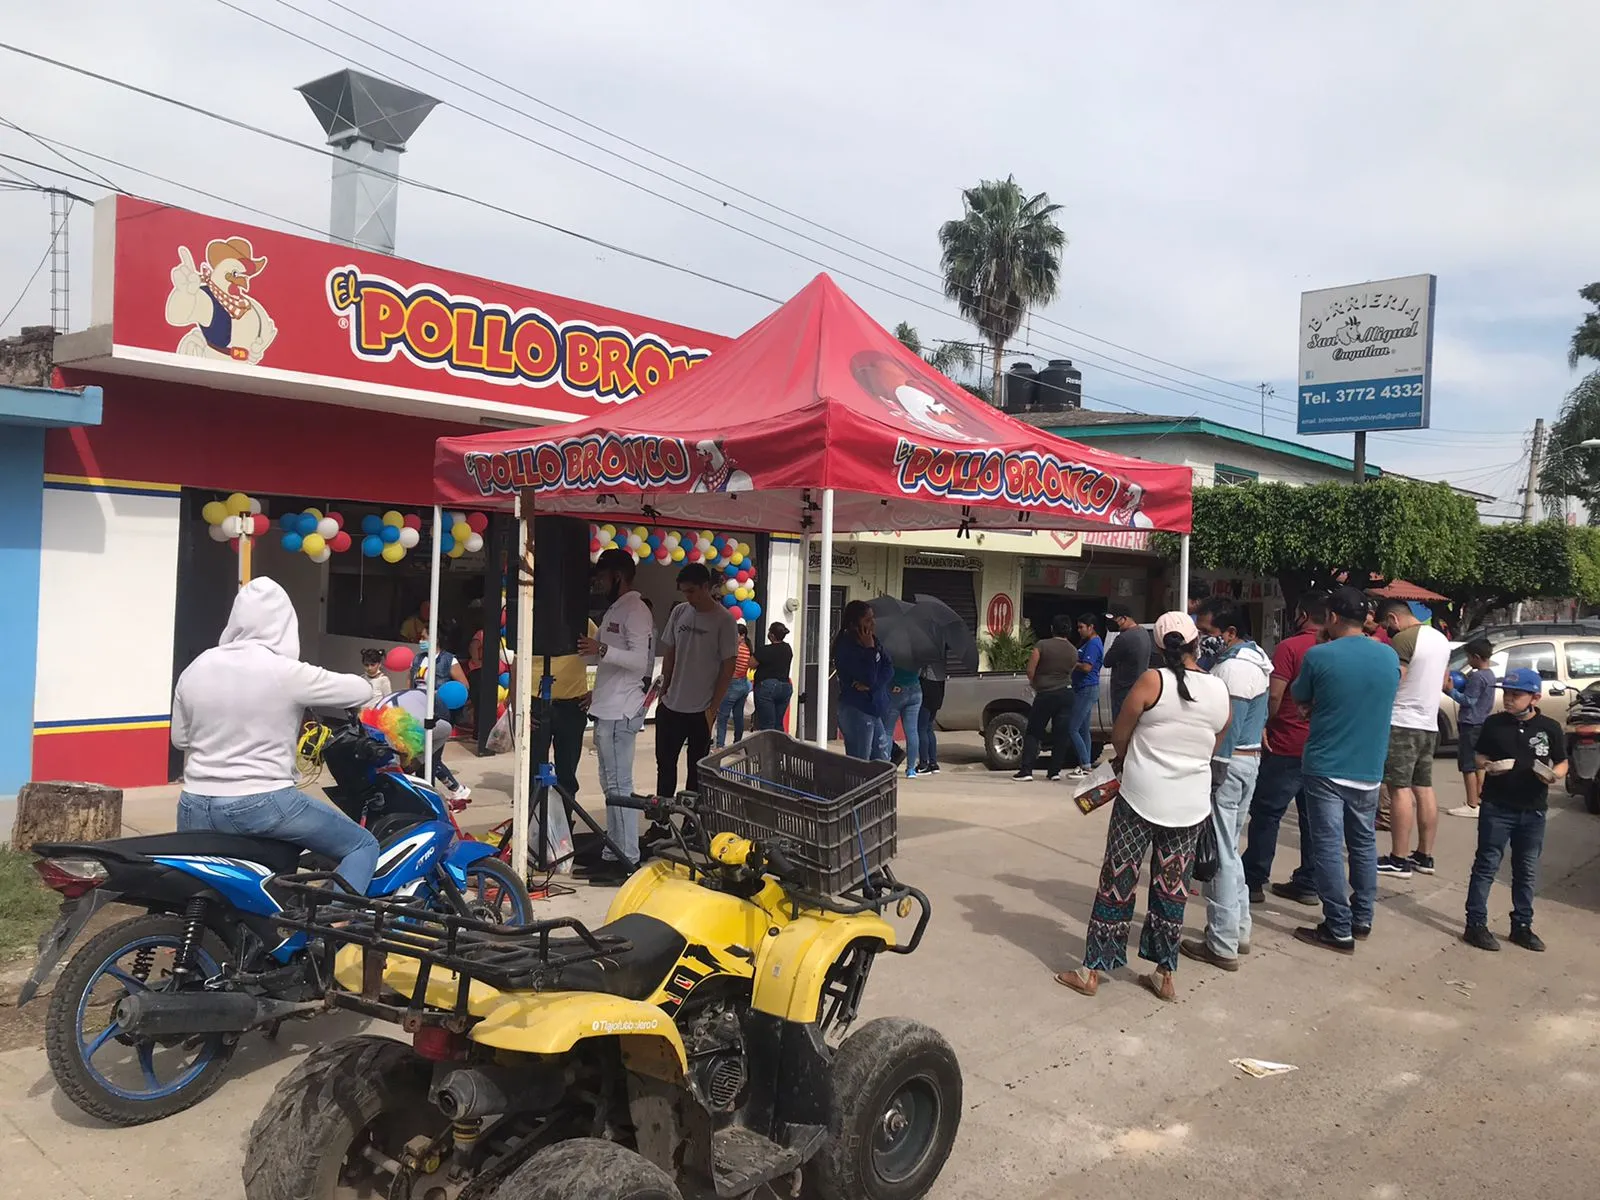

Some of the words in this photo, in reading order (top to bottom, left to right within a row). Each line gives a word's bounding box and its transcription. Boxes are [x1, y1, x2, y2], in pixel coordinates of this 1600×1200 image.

[332, 270, 361, 309] El
[359, 285, 558, 377] POLLO
[564, 330, 705, 396] BRO
[1307, 333, 1339, 349] San
[1360, 321, 1419, 344] Miguel
[1301, 391, 1331, 405] Tel.
[1335, 387, 1376, 402] 3772
[1380, 382, 1423, 398] 4332
[476, 444, 562, 490] POLLO
[563, 436, 686, 486] BRONCO
[902, 445, 1002, 492] POLLO
[1004, 456, 1118, 511] BRONCO
